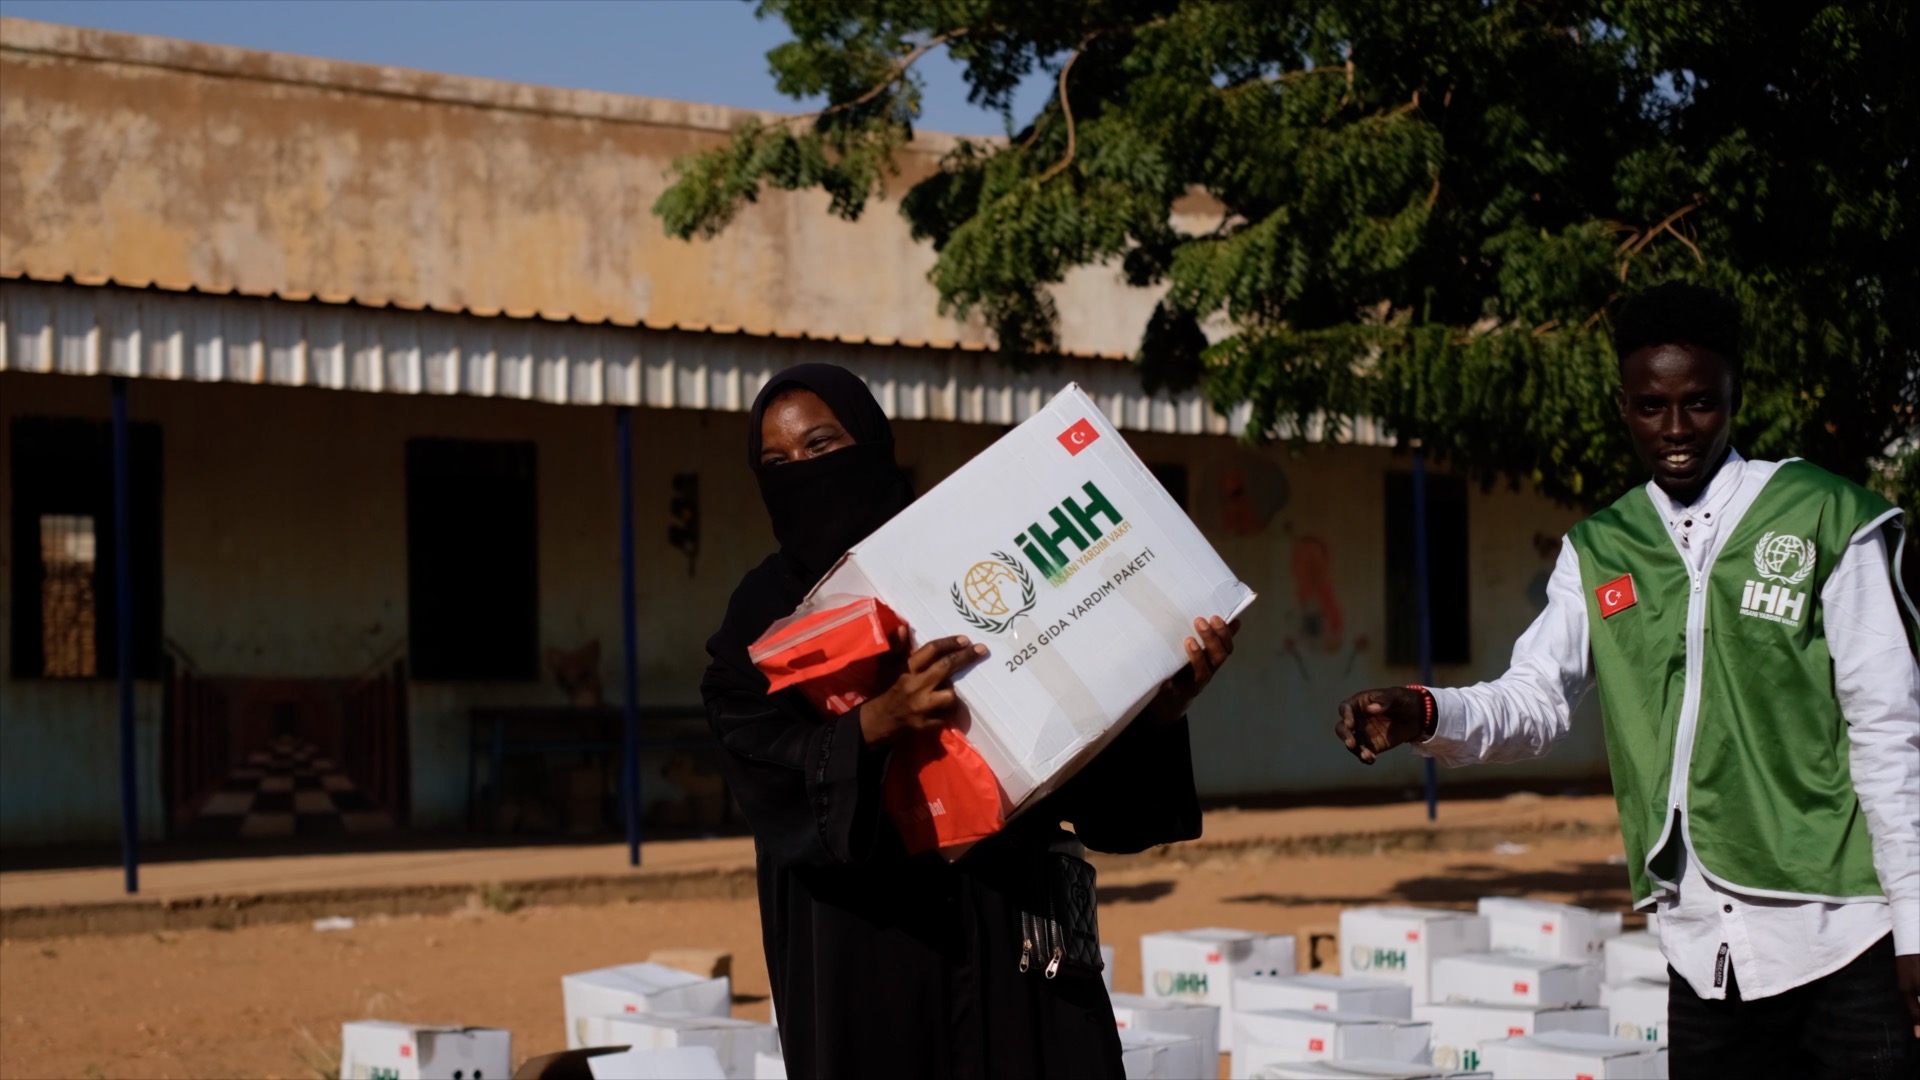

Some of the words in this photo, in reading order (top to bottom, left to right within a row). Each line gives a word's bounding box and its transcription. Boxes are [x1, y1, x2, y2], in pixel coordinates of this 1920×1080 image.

[1076, 538, 1110, 566] YARDIM
[1107, 520, 1133, 542] VAKFI
[1005, 643, 1038, 672] 2025
[1037, 619, 1071, 646] GIDA
[1067, 580, 1115, 621] YARDIM
[1113, 546, 1155, 585] PAKETİ
